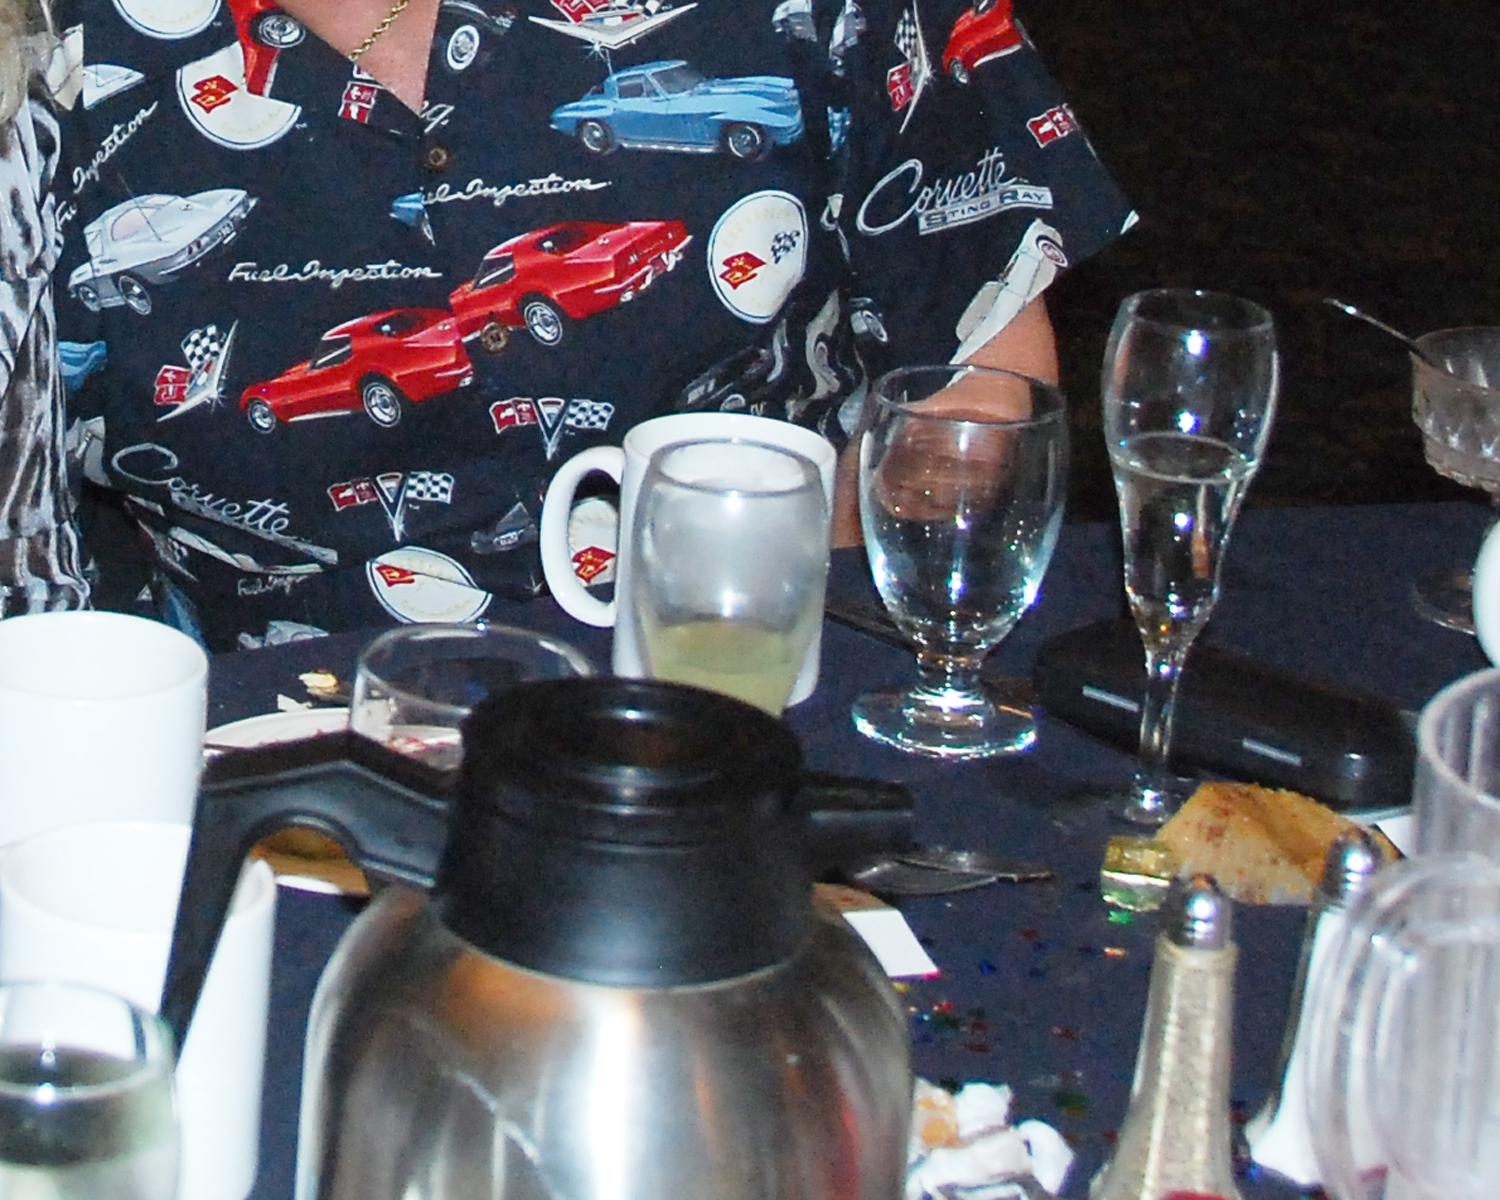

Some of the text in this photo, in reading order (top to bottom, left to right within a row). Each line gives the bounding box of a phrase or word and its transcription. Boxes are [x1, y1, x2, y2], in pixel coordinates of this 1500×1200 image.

[71, 100, 158, 194] Injection
[457, 172, 613, 207] Injection
[856, 147, 1017, 236] Corvette
[1001, 188, 1046, 204] RAY
[227, 259, 443, 289] Fuel Injection
[111, 442, 297, 541] Corvette
